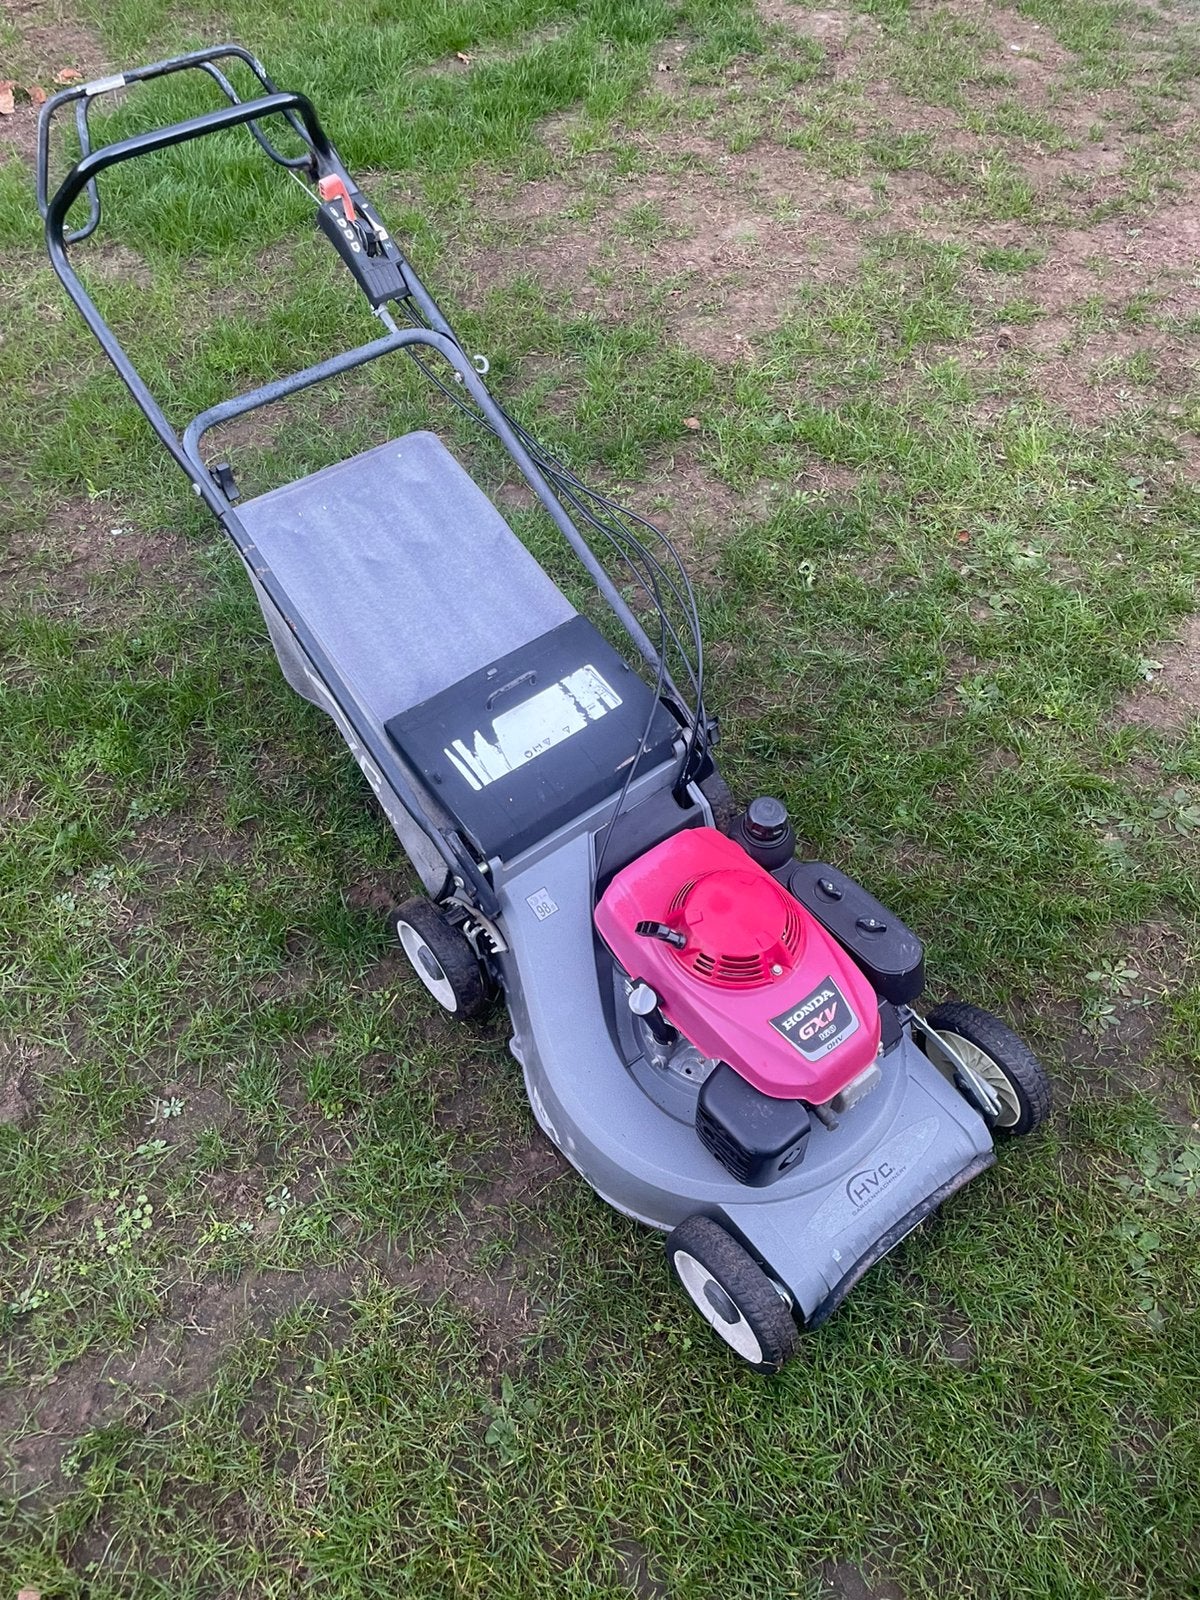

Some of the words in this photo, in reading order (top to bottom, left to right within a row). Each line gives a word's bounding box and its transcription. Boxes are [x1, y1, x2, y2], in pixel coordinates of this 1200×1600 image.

[536, 901, 551, 917] 98
[781, 990, 835, 1031] HONDA
[799, 1001, 837, 1040] GXV
[826, 1035, 843, 1050] OHV
[853, 1162, 893, 1201] HVC
